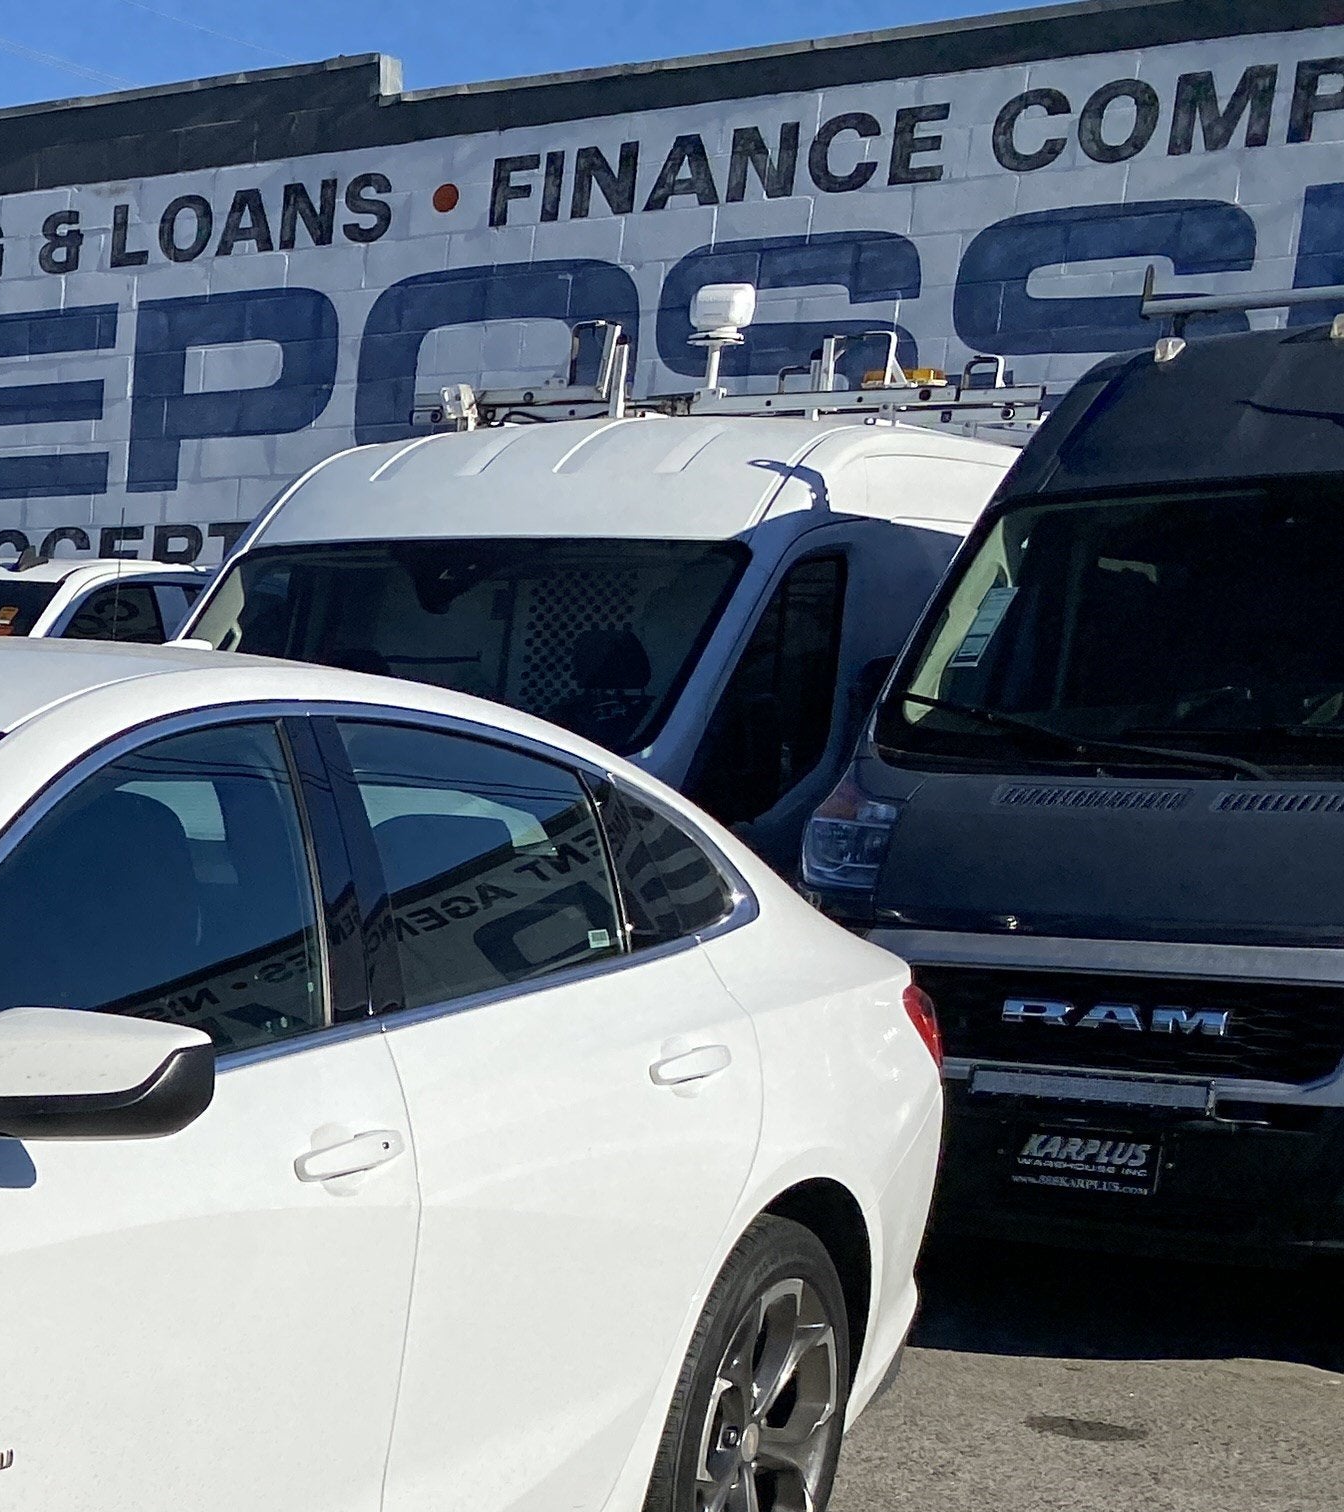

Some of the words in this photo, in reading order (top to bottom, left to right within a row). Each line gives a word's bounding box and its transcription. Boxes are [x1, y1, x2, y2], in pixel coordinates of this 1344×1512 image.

[39, 209, 84, 275] &
[112, 172, 393, 268] LOANS
[488, 103, 952, 228] FINANCE
[1001, 999, 1231, 1037] RAM
